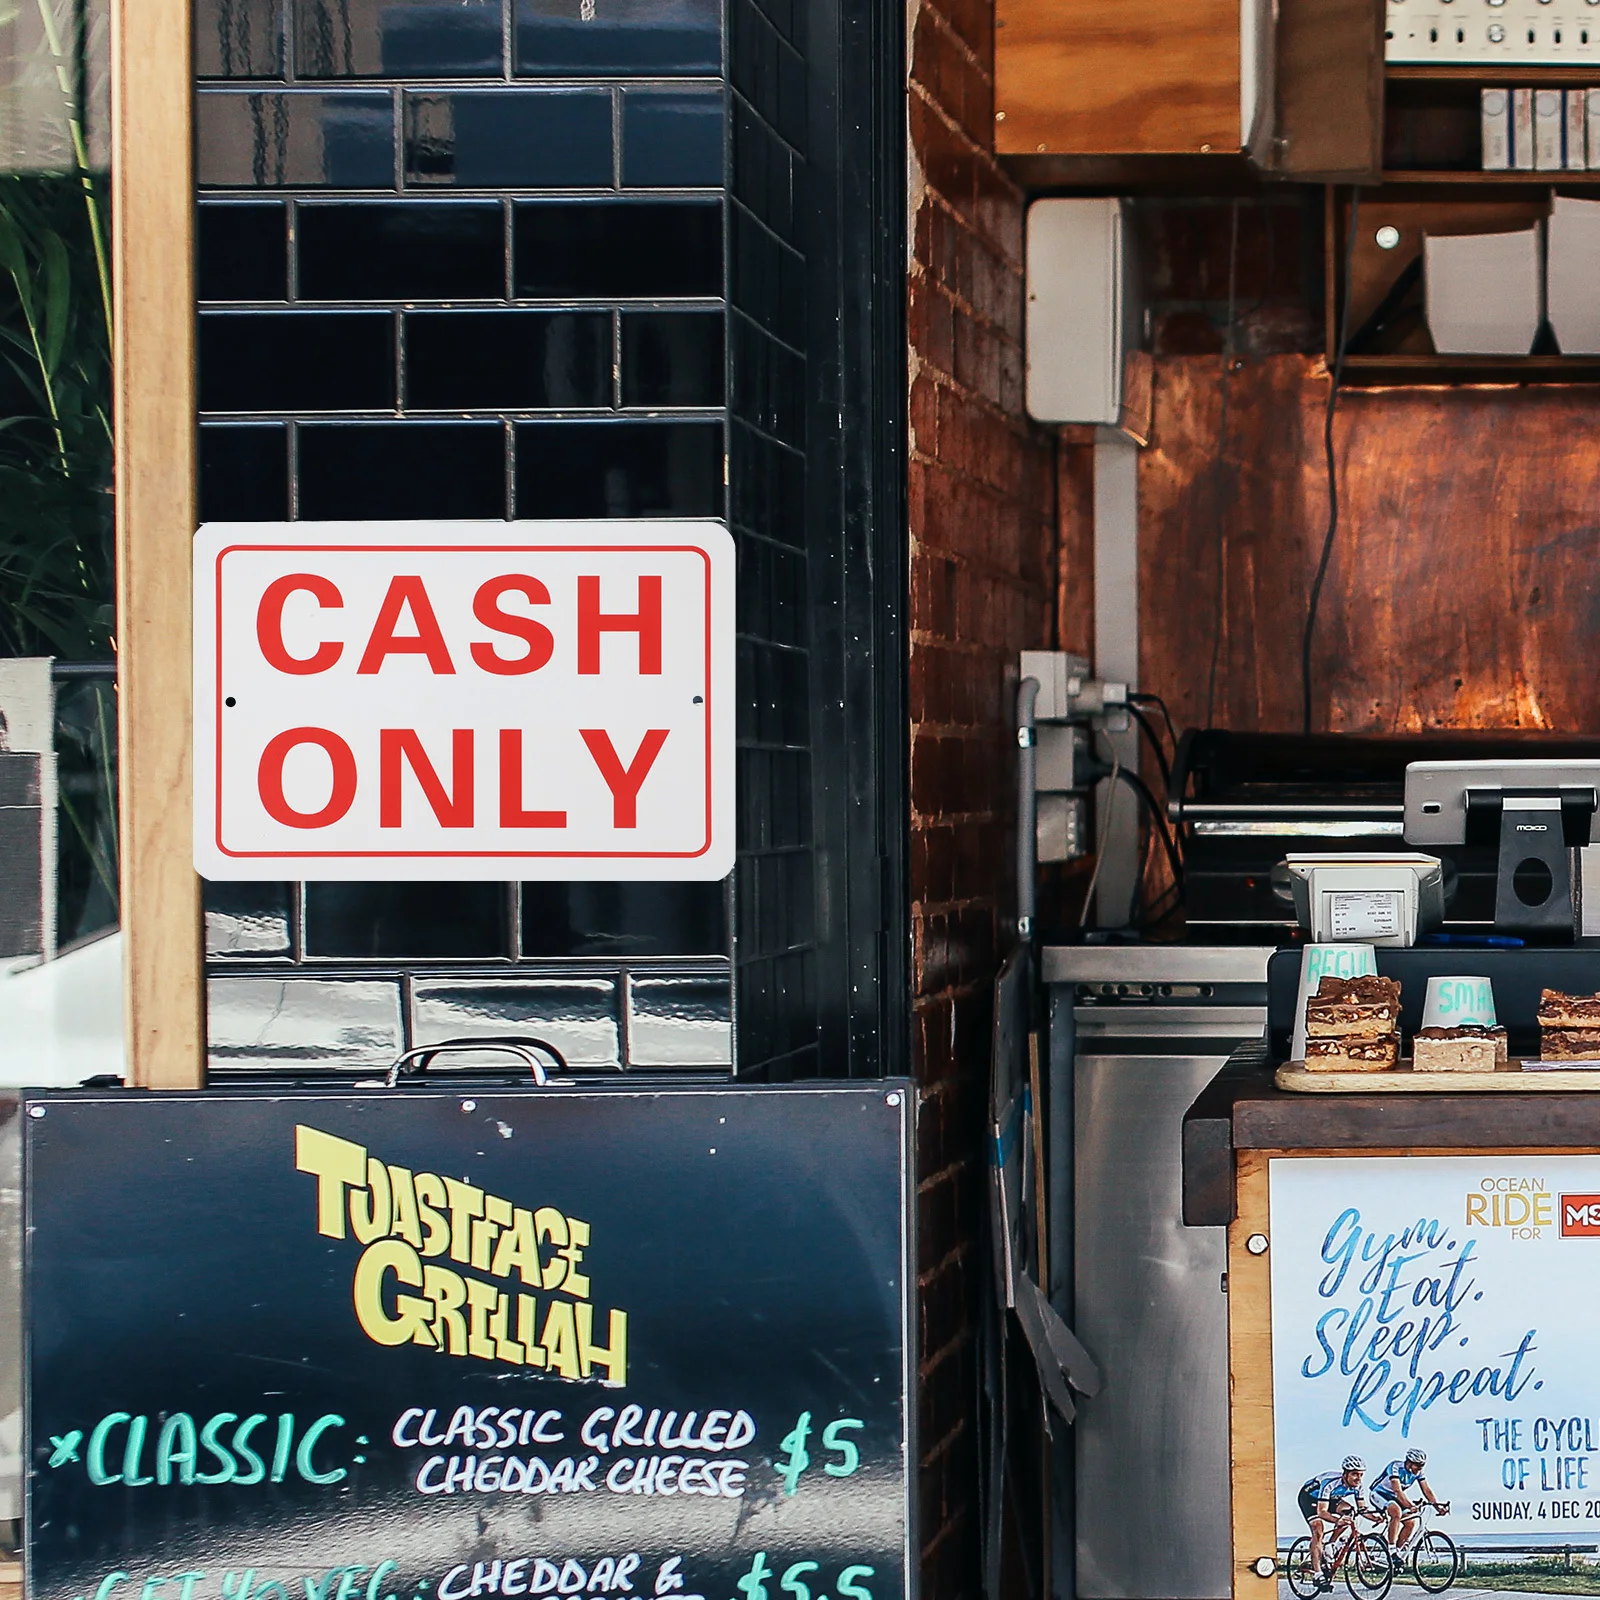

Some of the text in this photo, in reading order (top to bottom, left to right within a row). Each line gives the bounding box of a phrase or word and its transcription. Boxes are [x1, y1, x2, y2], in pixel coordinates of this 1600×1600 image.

[256, 573, 662, 675] CASH
[257, 726, 670, 829] ONLY
[1308, 948, 1378, 984] REGU
[295, 1123, 590, 1298] TOASTFACE
[1465, 1192, 1552, 1227] RIDE
[1480, 1177, 1545, 1192] OCEAN
[1319, 1207, 1456, 1298] Gym.
[1511, 1227, 1542, 1240] FOR
[354, 1239, 627, 1387] GRILLAH
[1375, 1239, 1484, 1324] Eat.
[1300, 1297, 1470, 1380] Sleep.
[1341, 1329, 1544, 1438] Repeat.
[393, 1405, 564, 1449] CLASSIC
[581, 1404, 757, 1454] GRILLED
[774, 1411, 864, 1496] $5
[1475, 1417, 1600, 1452] THE CYCL
[416, 1454, 749, 1499] CHEDDAR CHEESE
[1502, 1456, 1589, 1491] OF LIFE
[1472, 1501, 1533, 1520] SUNDAY,
[1537, 1501, 1547, 1519] 4
[1552, 1501, 1580, 1519] DEC
[436, 1552, 641, 1600] CHEDDAR
